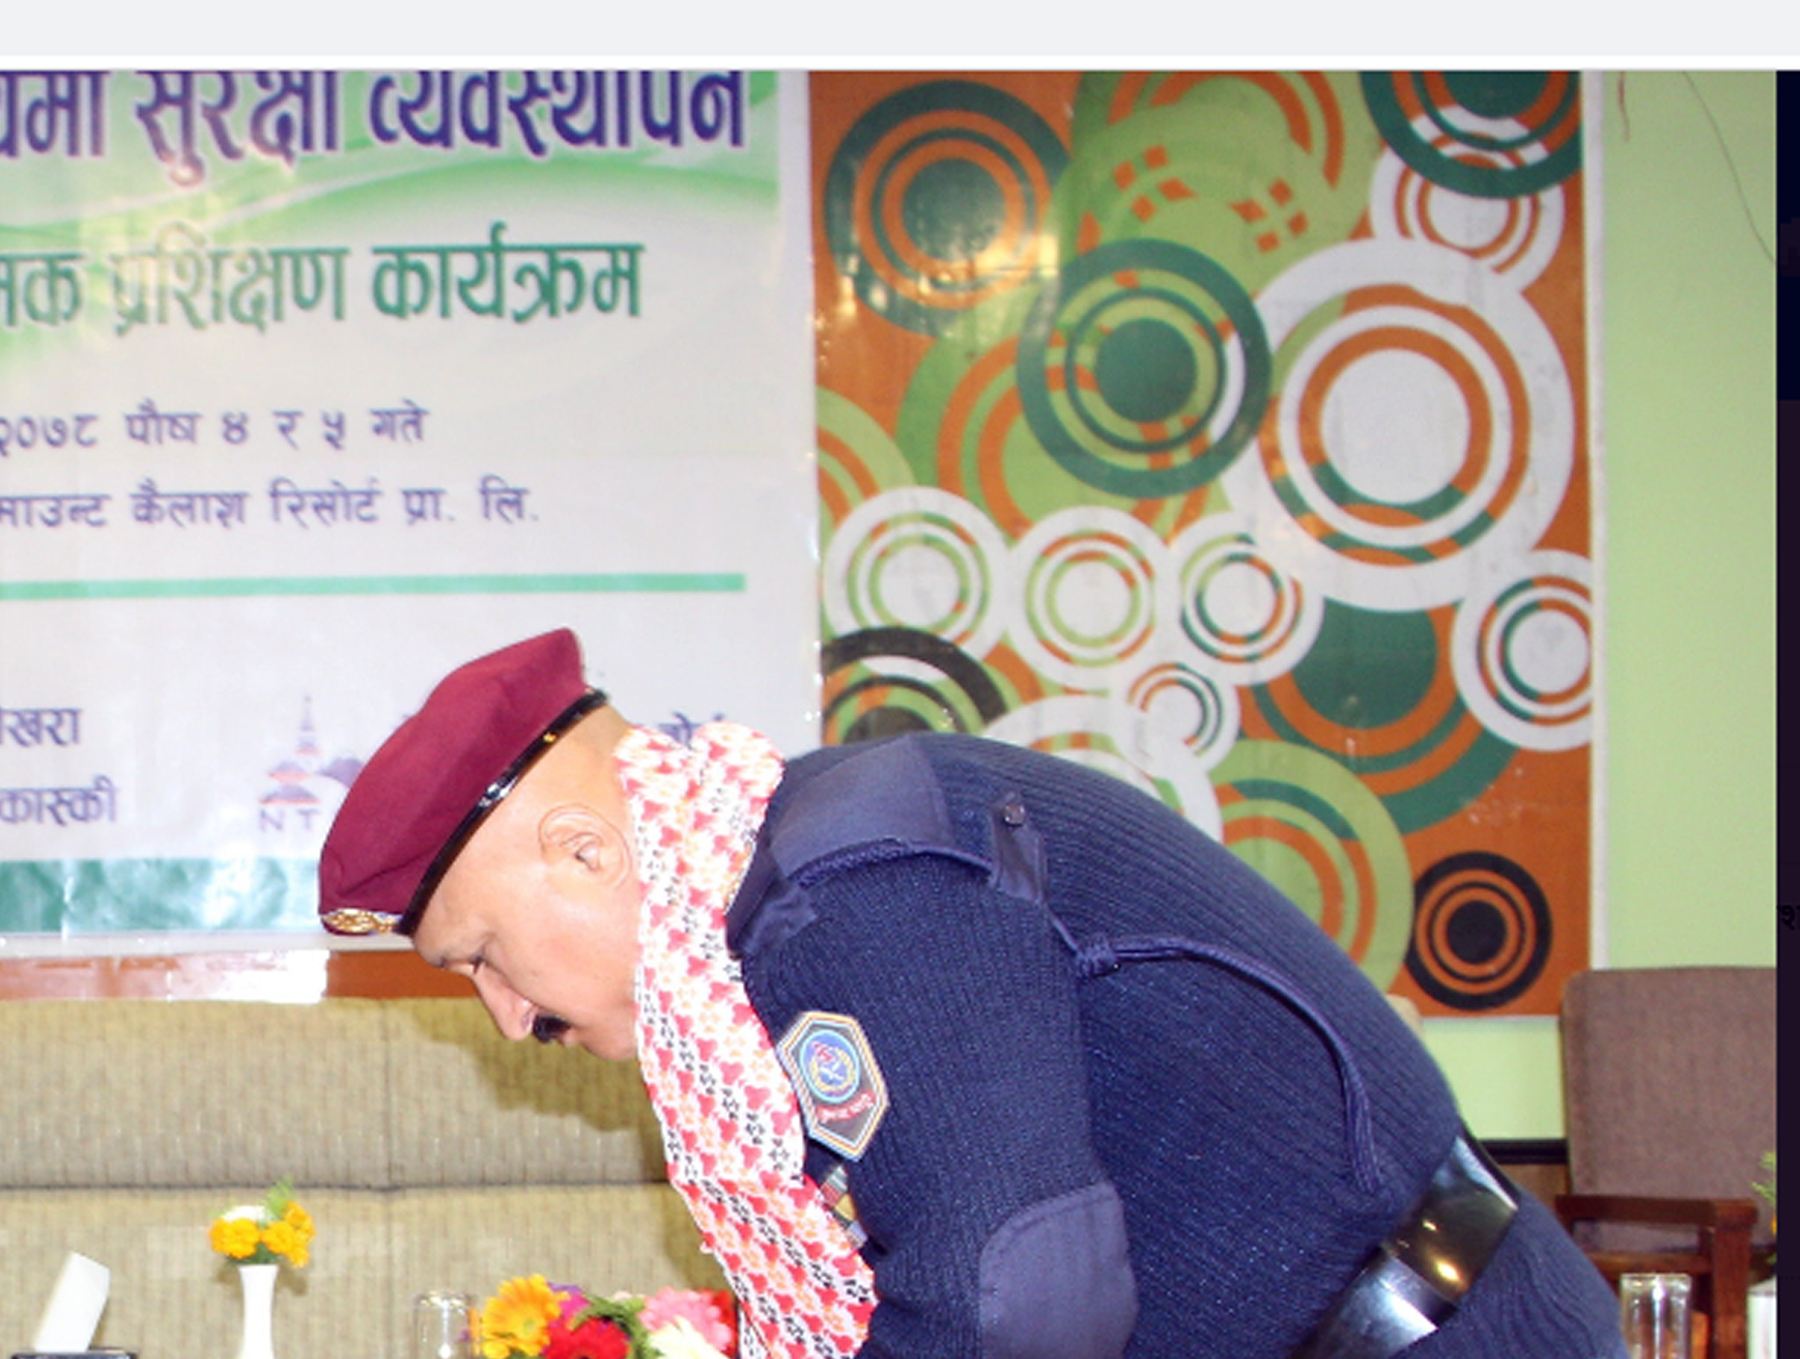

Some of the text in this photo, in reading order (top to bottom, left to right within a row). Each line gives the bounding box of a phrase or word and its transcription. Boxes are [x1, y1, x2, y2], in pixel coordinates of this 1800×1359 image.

[134, 71, 340, 187] सुरक्षा
[369, 71, 745, 157] व्यवस्थापन
[112, 222, 349, 334] प्रशिक्षण
[372, 221, 644, 322] कार्यक्रम
[125, 398, 201, 446] पौष
[221, 410, 249, 445] ४
[273, 409, 303, 449] र
[322, 410, 345, 450] ५
[369, 399, 430, 443] गते
[130, 478, 249, 529] कैलाश
